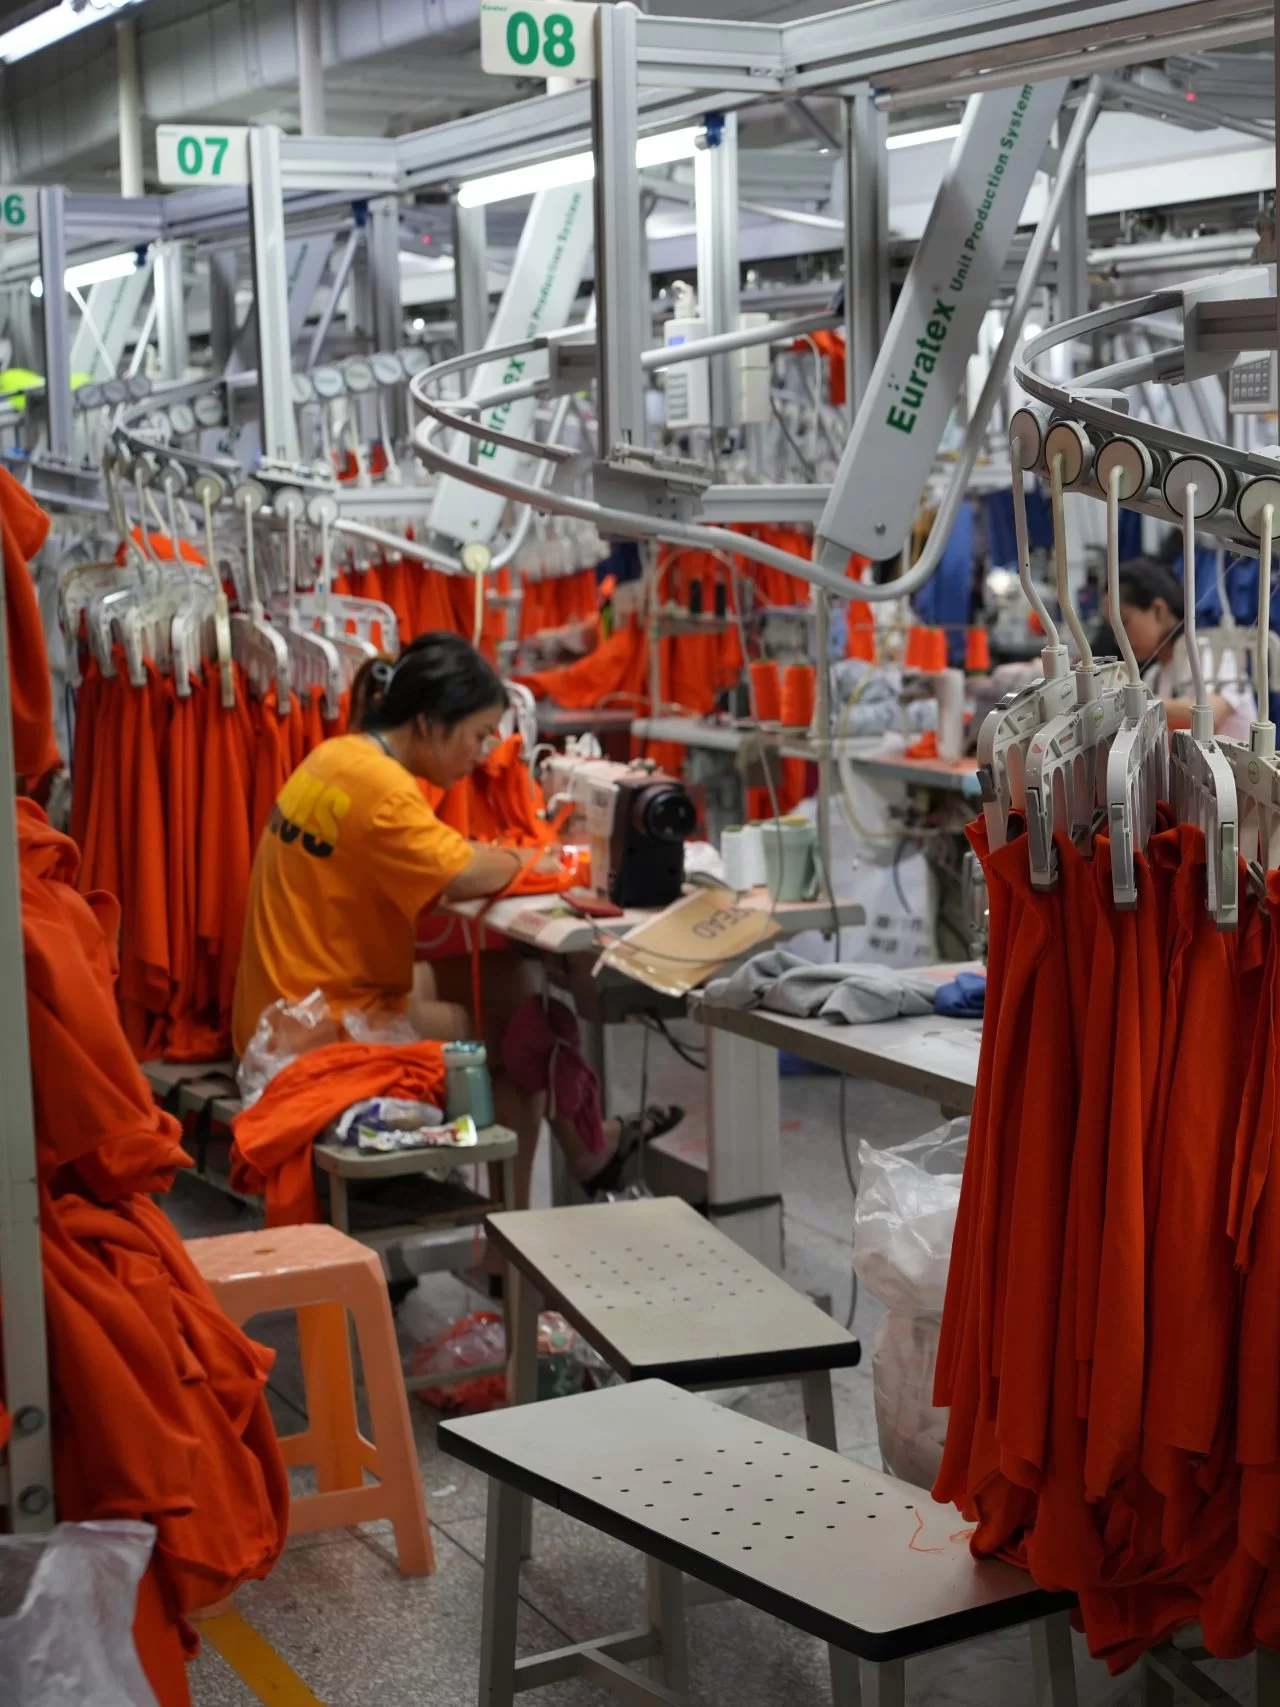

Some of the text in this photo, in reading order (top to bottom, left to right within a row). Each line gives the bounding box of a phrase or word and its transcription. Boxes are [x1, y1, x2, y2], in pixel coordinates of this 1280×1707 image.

[507, 11, 575, 67] 08
[178, 136, 228, 176] 07
[0, 194, 25, 226] 6
[951, 84, 1034, 292] Unit Production System
[885, 299, 956, 434] Euratex
